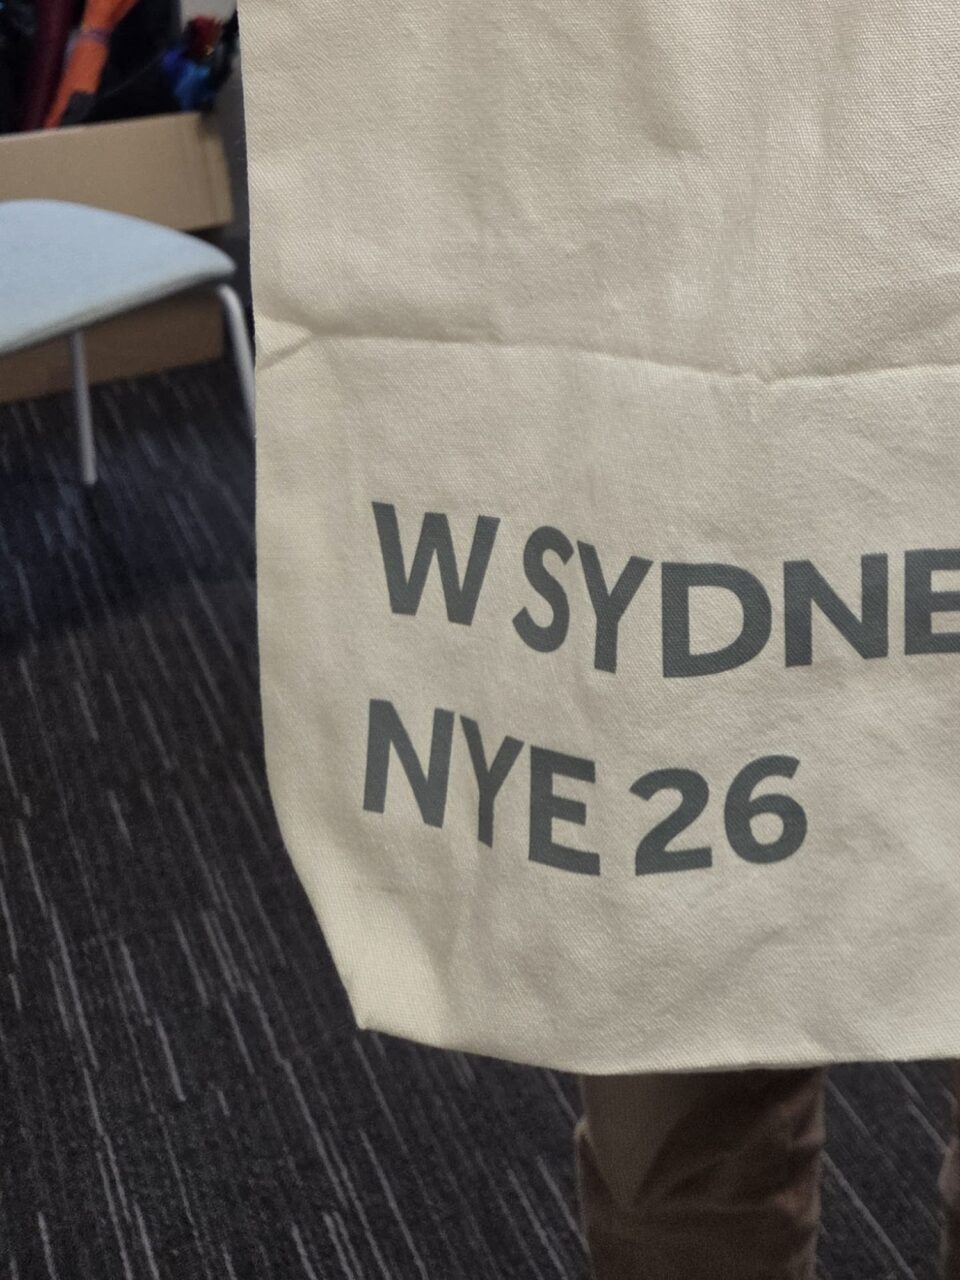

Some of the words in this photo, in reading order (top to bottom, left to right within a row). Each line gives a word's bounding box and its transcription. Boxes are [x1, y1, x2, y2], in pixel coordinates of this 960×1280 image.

[371, 501, 500, 627] W
[362, 698, 602, 877] NYE
[629, 754, 809, 877] 26
